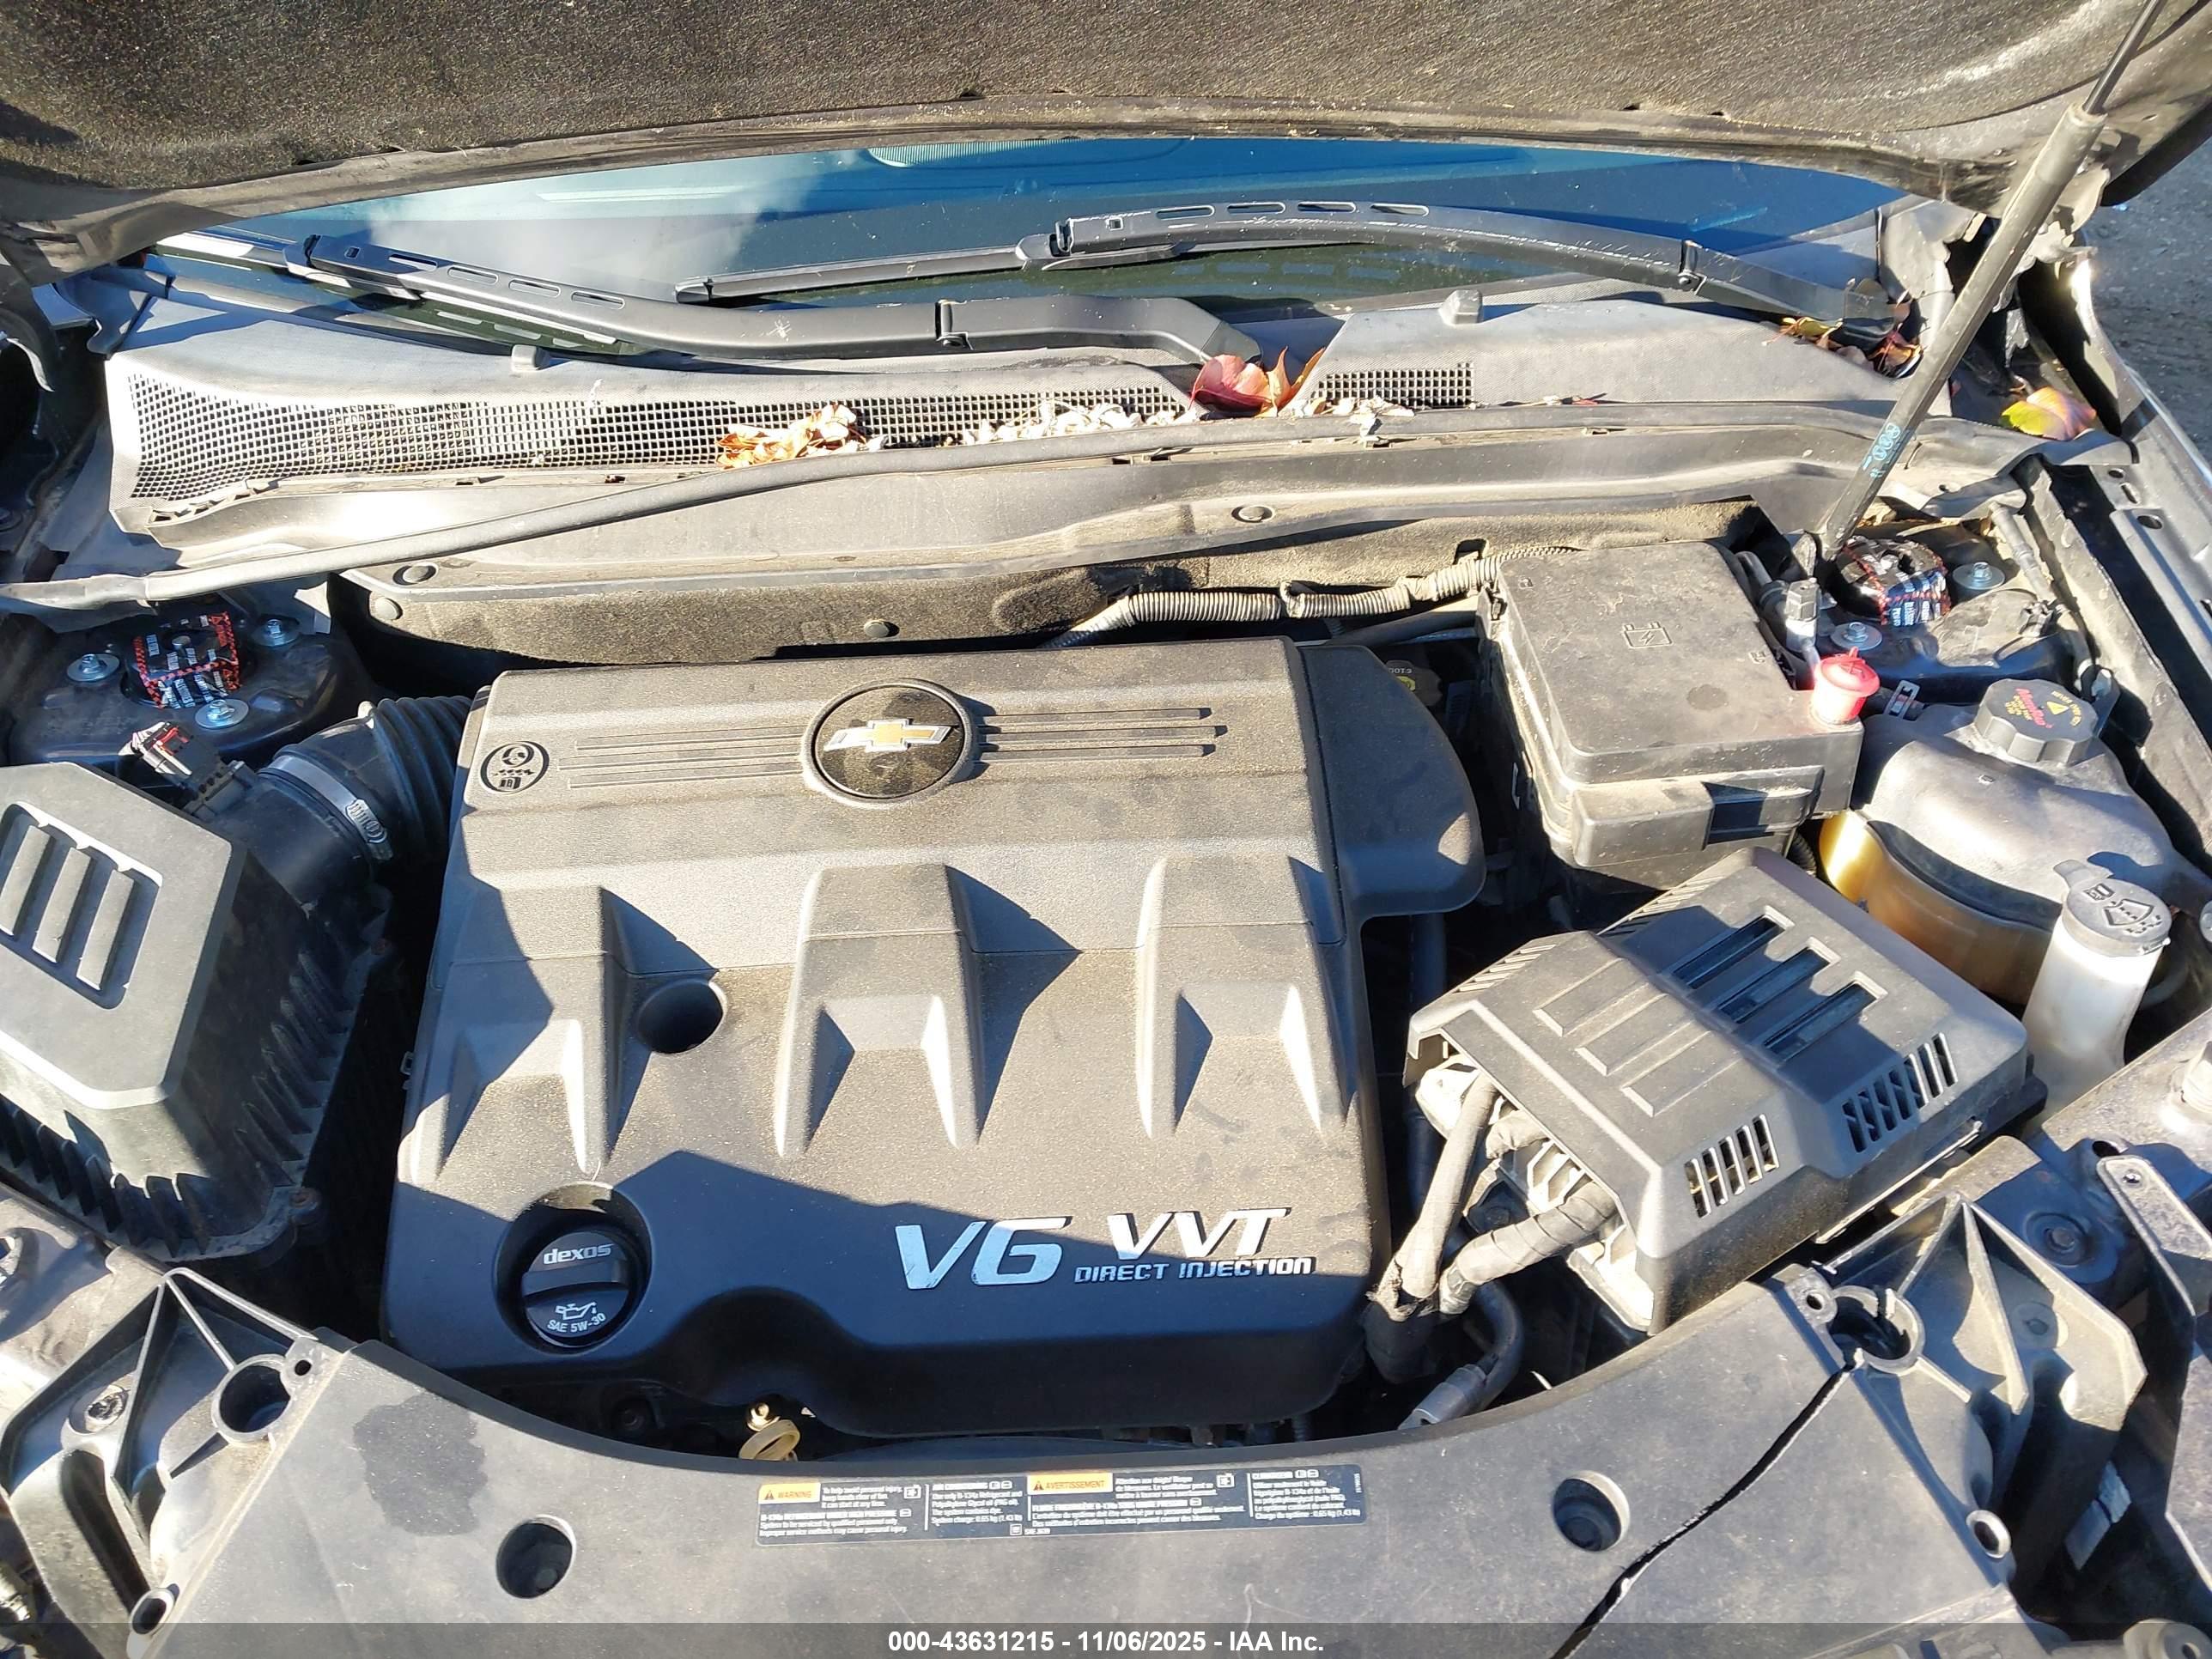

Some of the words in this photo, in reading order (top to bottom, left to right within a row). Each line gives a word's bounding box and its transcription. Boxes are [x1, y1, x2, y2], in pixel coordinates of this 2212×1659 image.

[543, 1243, 614, 1265] dexos
[896, 1216, 1073, 1290] V6
[1106, 1207, 1291, 1260] VVT
[1073, 1262, 1170, 1284] DIRECT
[1177, 1256, 1316, 1279] INJECTION
[547, 1319, 568, 1333] SAE
[570, 1312, 606, 1333] 5W-30
[1045, 1480, 1105, 1490] AVERTISSEMENT
